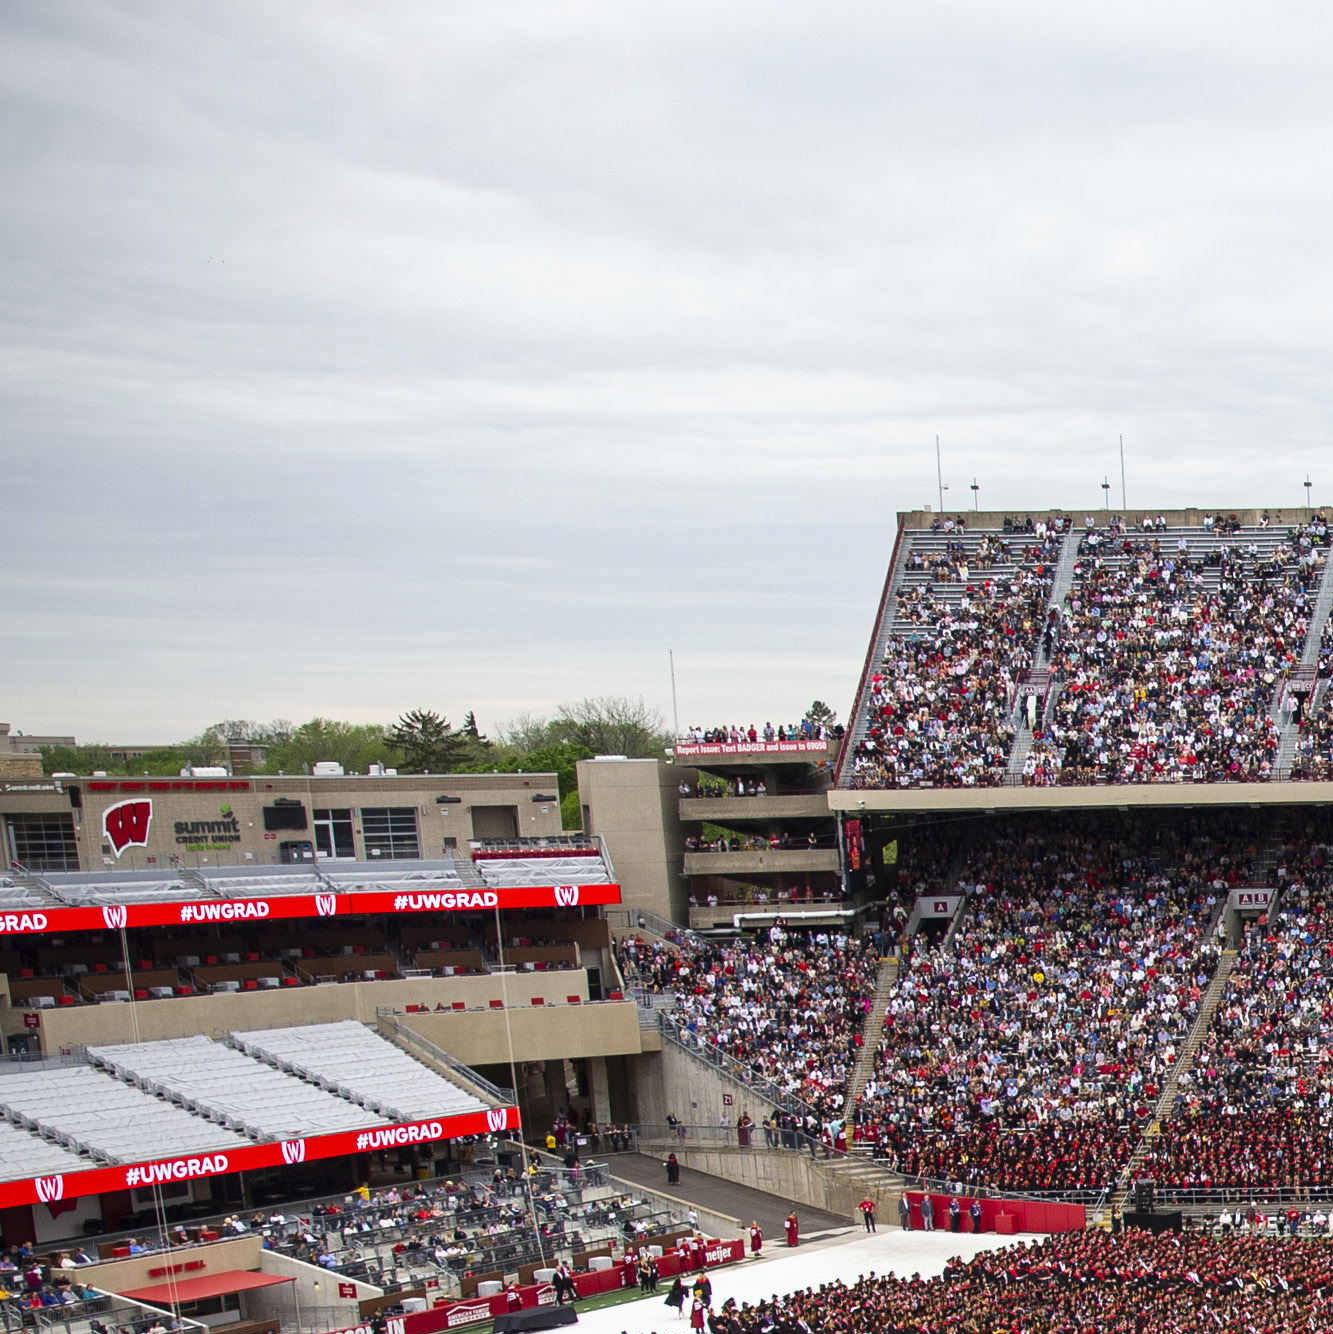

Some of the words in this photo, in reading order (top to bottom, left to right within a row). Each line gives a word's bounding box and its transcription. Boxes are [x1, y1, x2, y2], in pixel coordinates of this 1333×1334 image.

[676, 745, 699, 756] Report
[722, 744, 736, 753] Text
[737, 743, 765, 753] BADGER
[766, 743, 778, 751] and
[780, 742, 797, 751] issue
[799, 742, 806, 751] to
[806, 741, 827, 750] 69050
[174, 814, 240, 834] summit
[175, 835, 209, 844] CREDIT
[211, 834, 241, 843] UNION
[393, 892, 498, 910] #UWGRAD
[180, 901, 270, 921] #UWGRAD
[356, 1122, 443, 1150] #UWGRAD
[126, 1155, 229, 1186] #UWGRAD
[448, 1310, 473, 1320] AMERICAN
